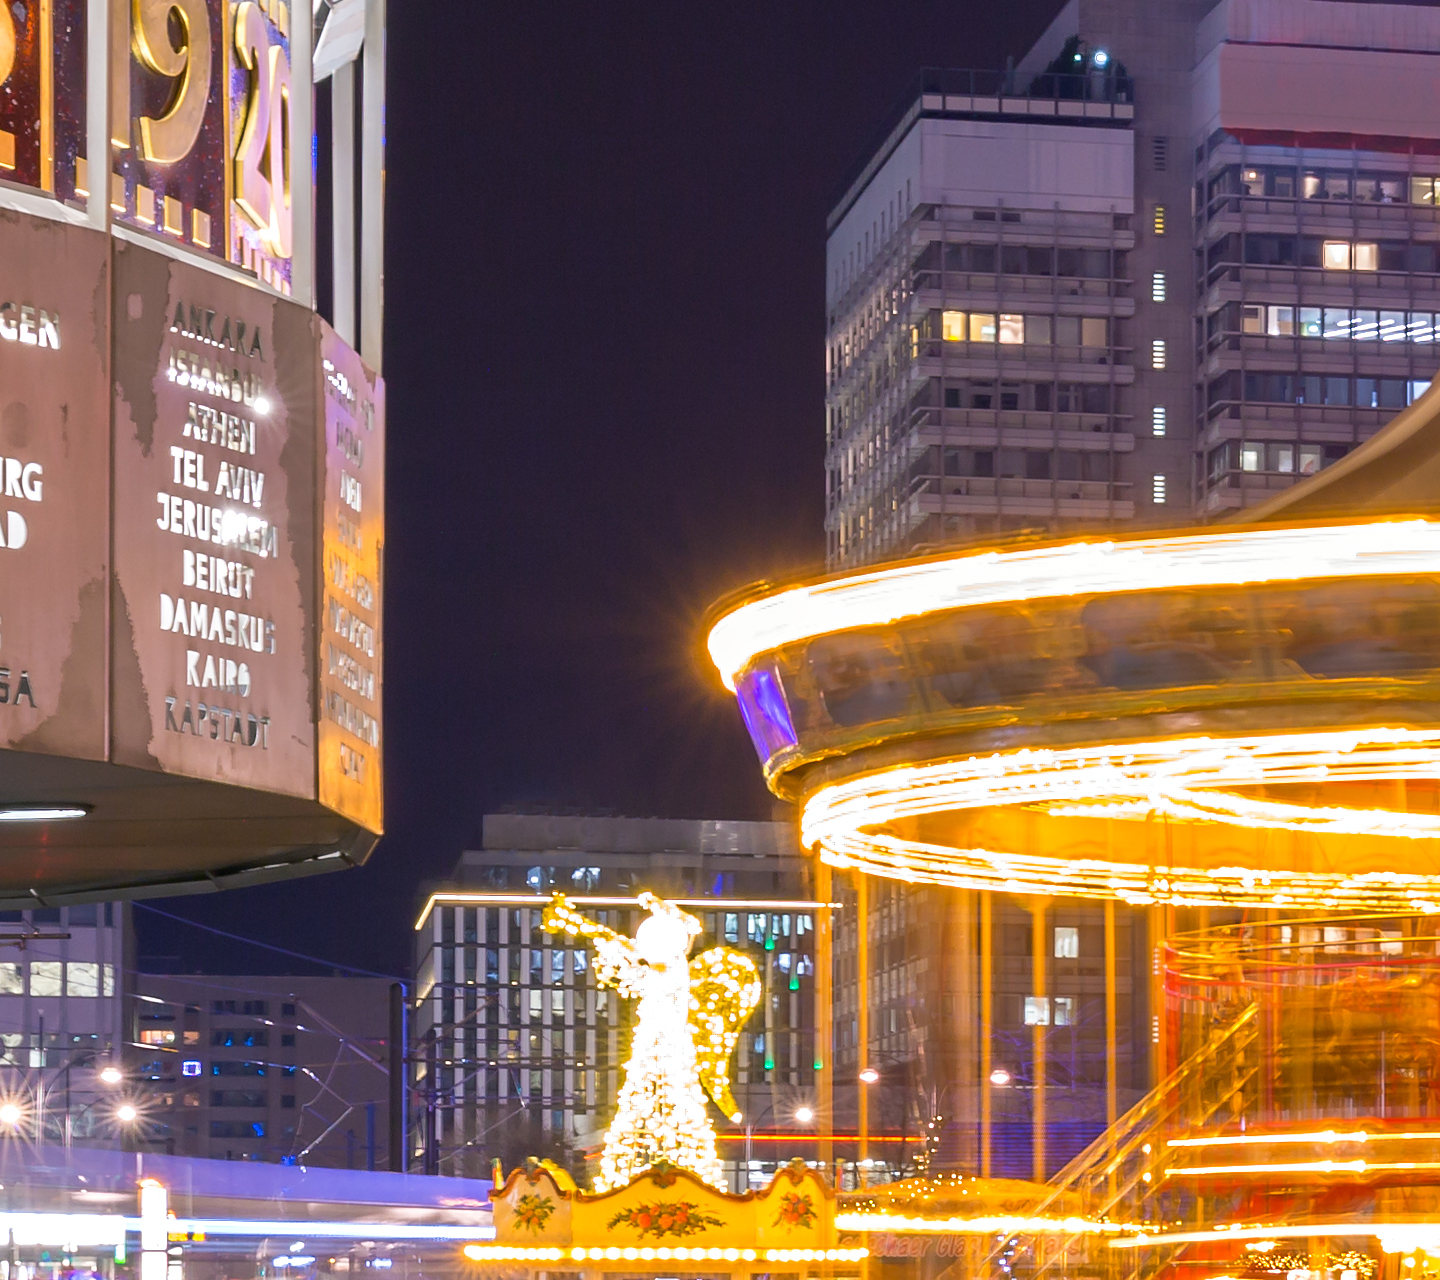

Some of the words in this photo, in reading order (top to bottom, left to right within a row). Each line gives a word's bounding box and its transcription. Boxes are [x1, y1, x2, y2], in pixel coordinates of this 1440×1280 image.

[169, 300, 266, 364] ANKARA
[182, 401, 257, 456] ATHEN
[170, 445, 210, 493] TEL
[214, 460, 265, 509] AVIV
[183, 549, 256, 601] BEIRUT
[159, 593, 277, 656] DAMASKUS
[186, 649, 252, 699] KAIRO
[164, 696, 272, 751] KAPSTADT
